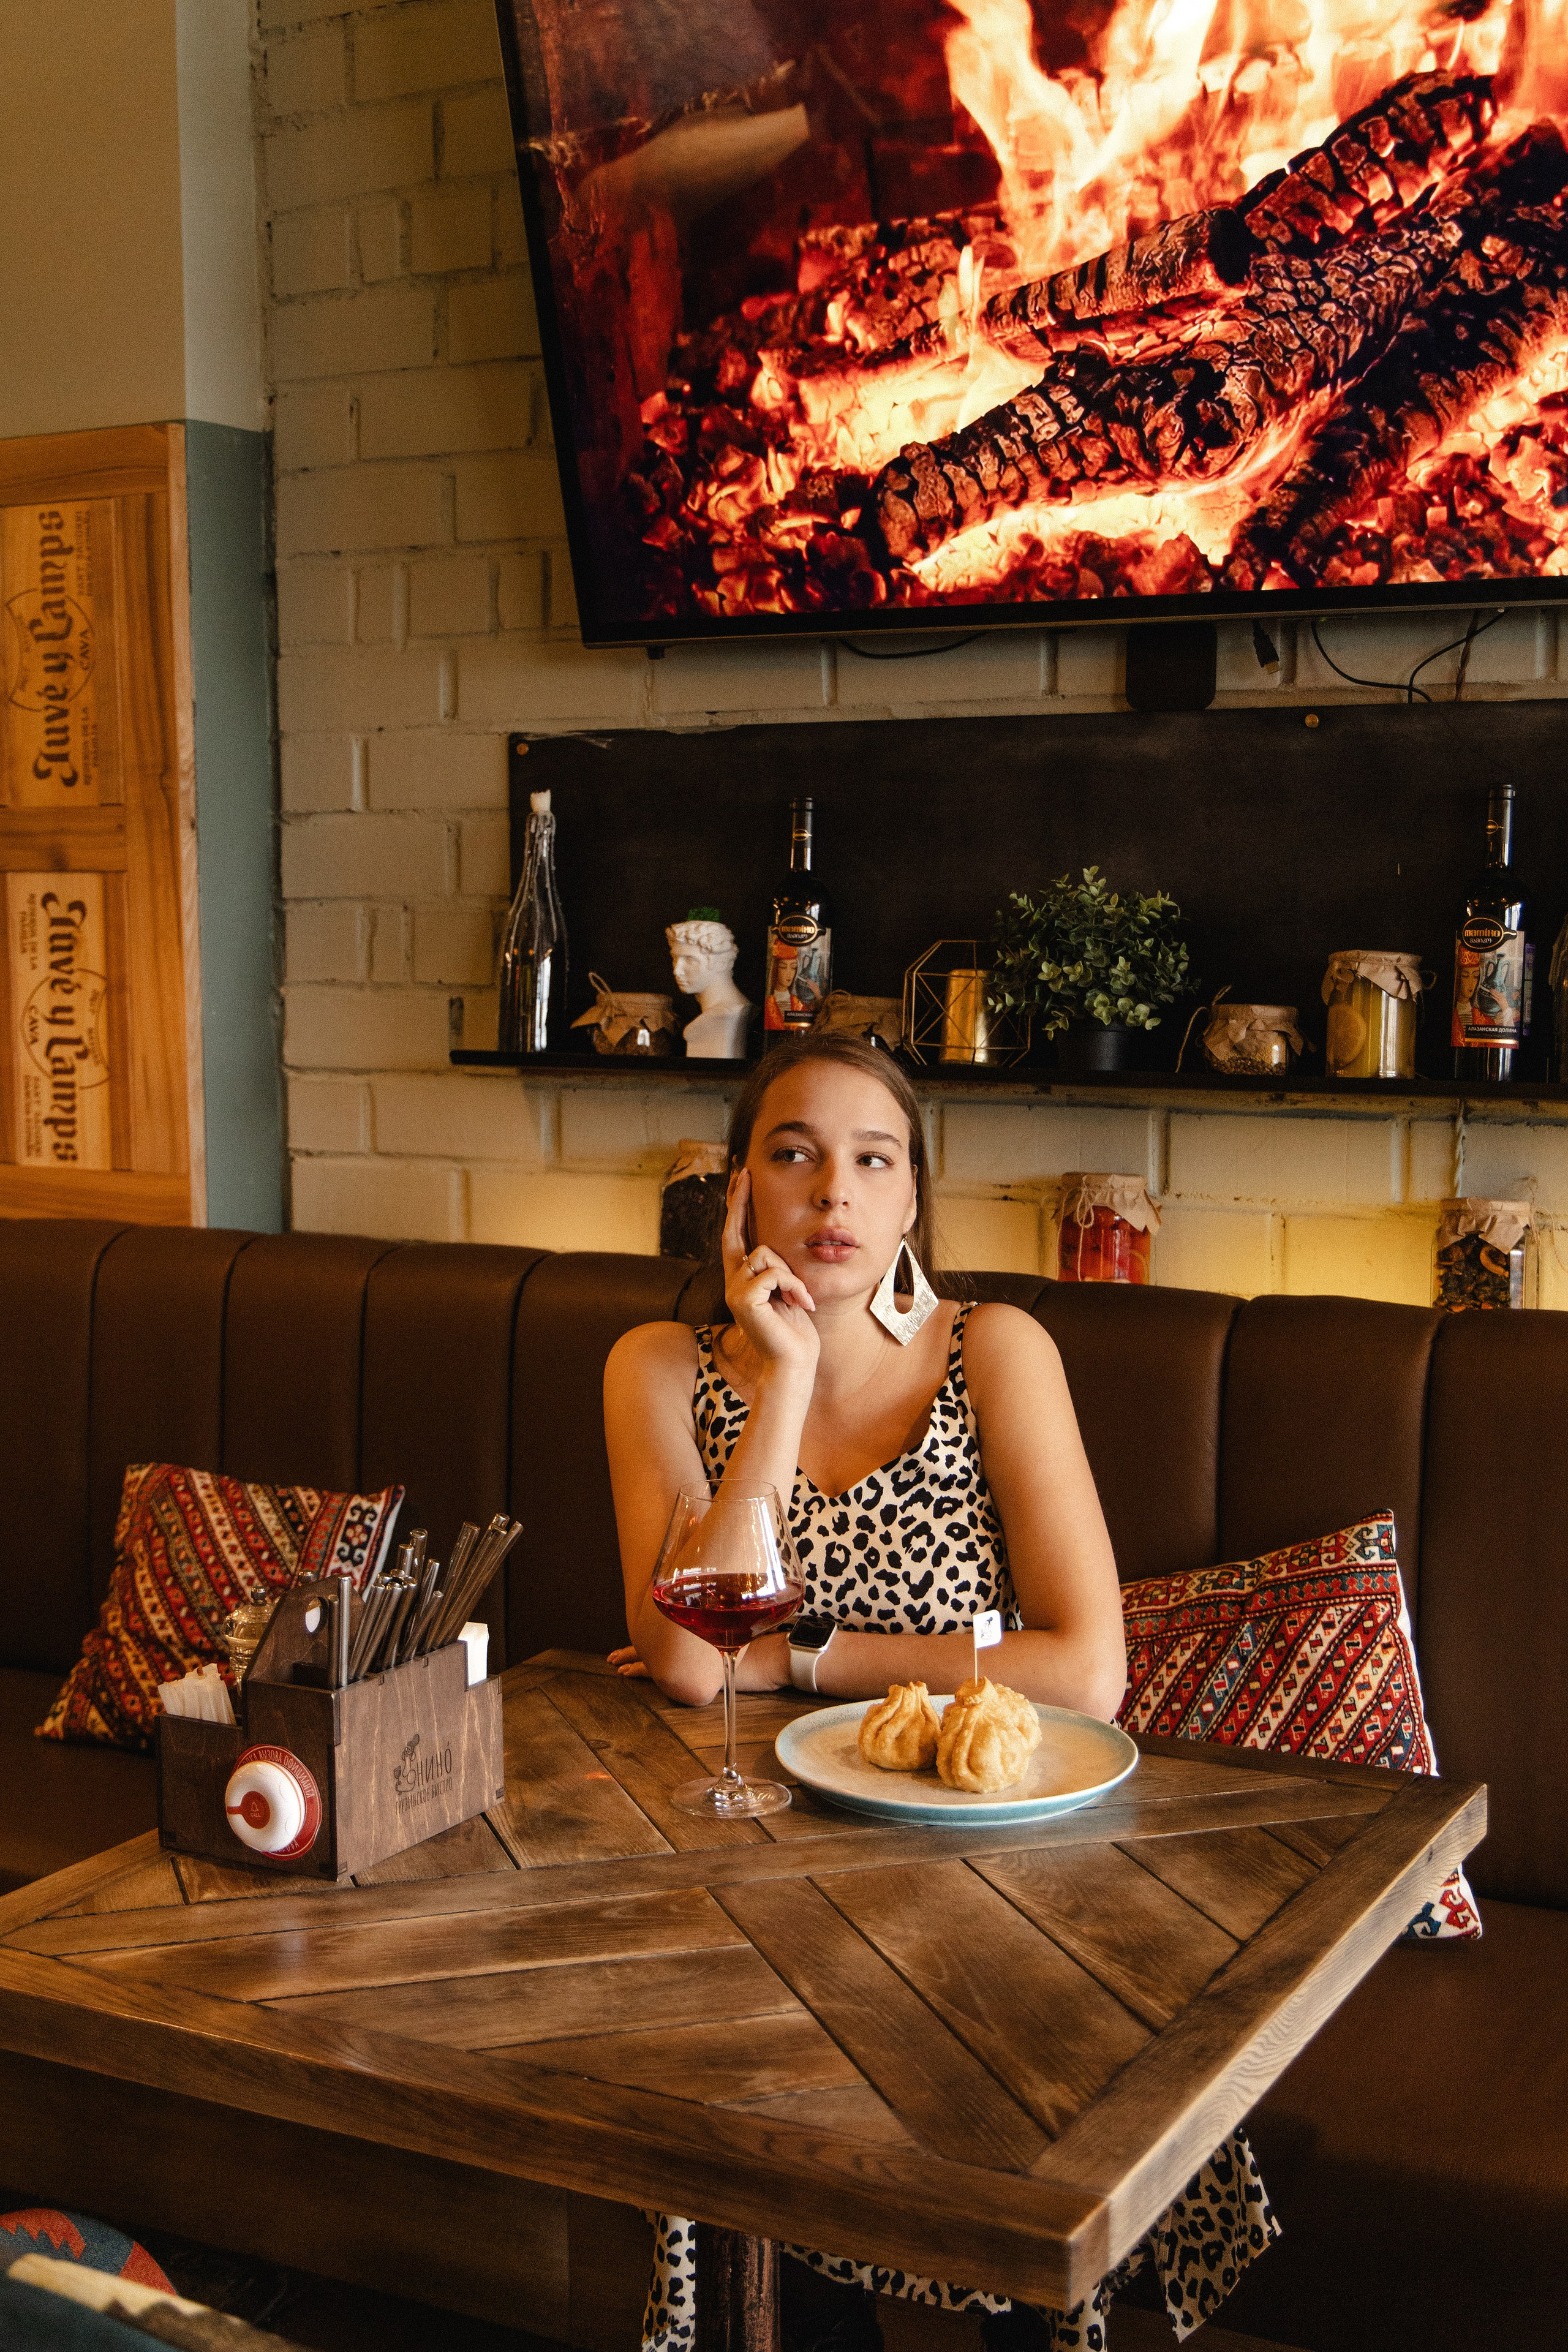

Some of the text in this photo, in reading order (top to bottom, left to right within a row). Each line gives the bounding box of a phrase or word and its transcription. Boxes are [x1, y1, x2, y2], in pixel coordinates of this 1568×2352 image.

[29, 511, 78, 787] Juvé y Camps
[79, 629, 91, 671] CAVA
[28, 1005, 39, 1044] CAVA
[40, 892, 89, 1161] Juvé y Camps
[258, 1749, 282, 1763] ВЫЗОВА
[284, 1755, 315, 1798] ОФИЦИАНТА
[396, 1777, 453, 1815] ГРУЗИНСКОЕ БИСТРО
